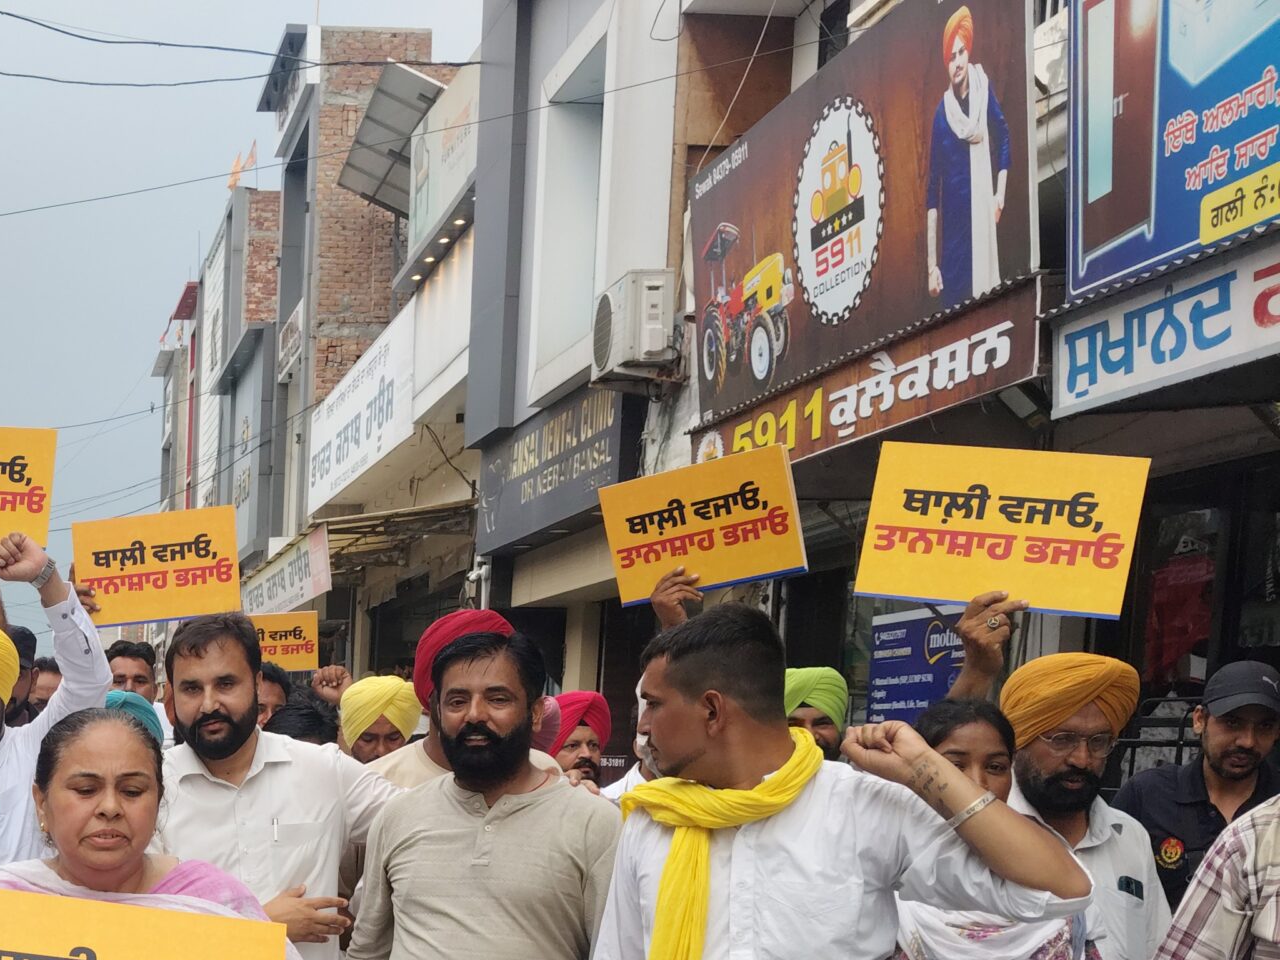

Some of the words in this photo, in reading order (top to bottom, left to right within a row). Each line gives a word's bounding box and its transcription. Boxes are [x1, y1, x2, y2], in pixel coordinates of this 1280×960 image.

[1210, 187, 1246, 228] ਗਲੀ
[815, 227, 862, 277] 5911
[813, 259, 868, 298] COLLECTION
[542, 409, 578, 463] DENTAL
[732, 386, 824, 450] 5911
[573, 437, 612, 480] BANSAL
[691, 480, 769, 520] ਵਜਾਓ,
[998, 490, 1104, 533] ਵਜਾਓ,
[150, 534, 218, 565] ਵਜਾਓ,
[617, 530, 717, 570] ਤਾਨਾਸ਼ਾਹ
[720, 504, 791, 548] ਭਜਾਓ
[873, 523, 1022, 559] ਤਾਨਾਸ਼ਾਹ
[1024, 532, 1125, 570] ਭਜਾਓ
[174, 558, 234, 588] ਭਜਾਓ
